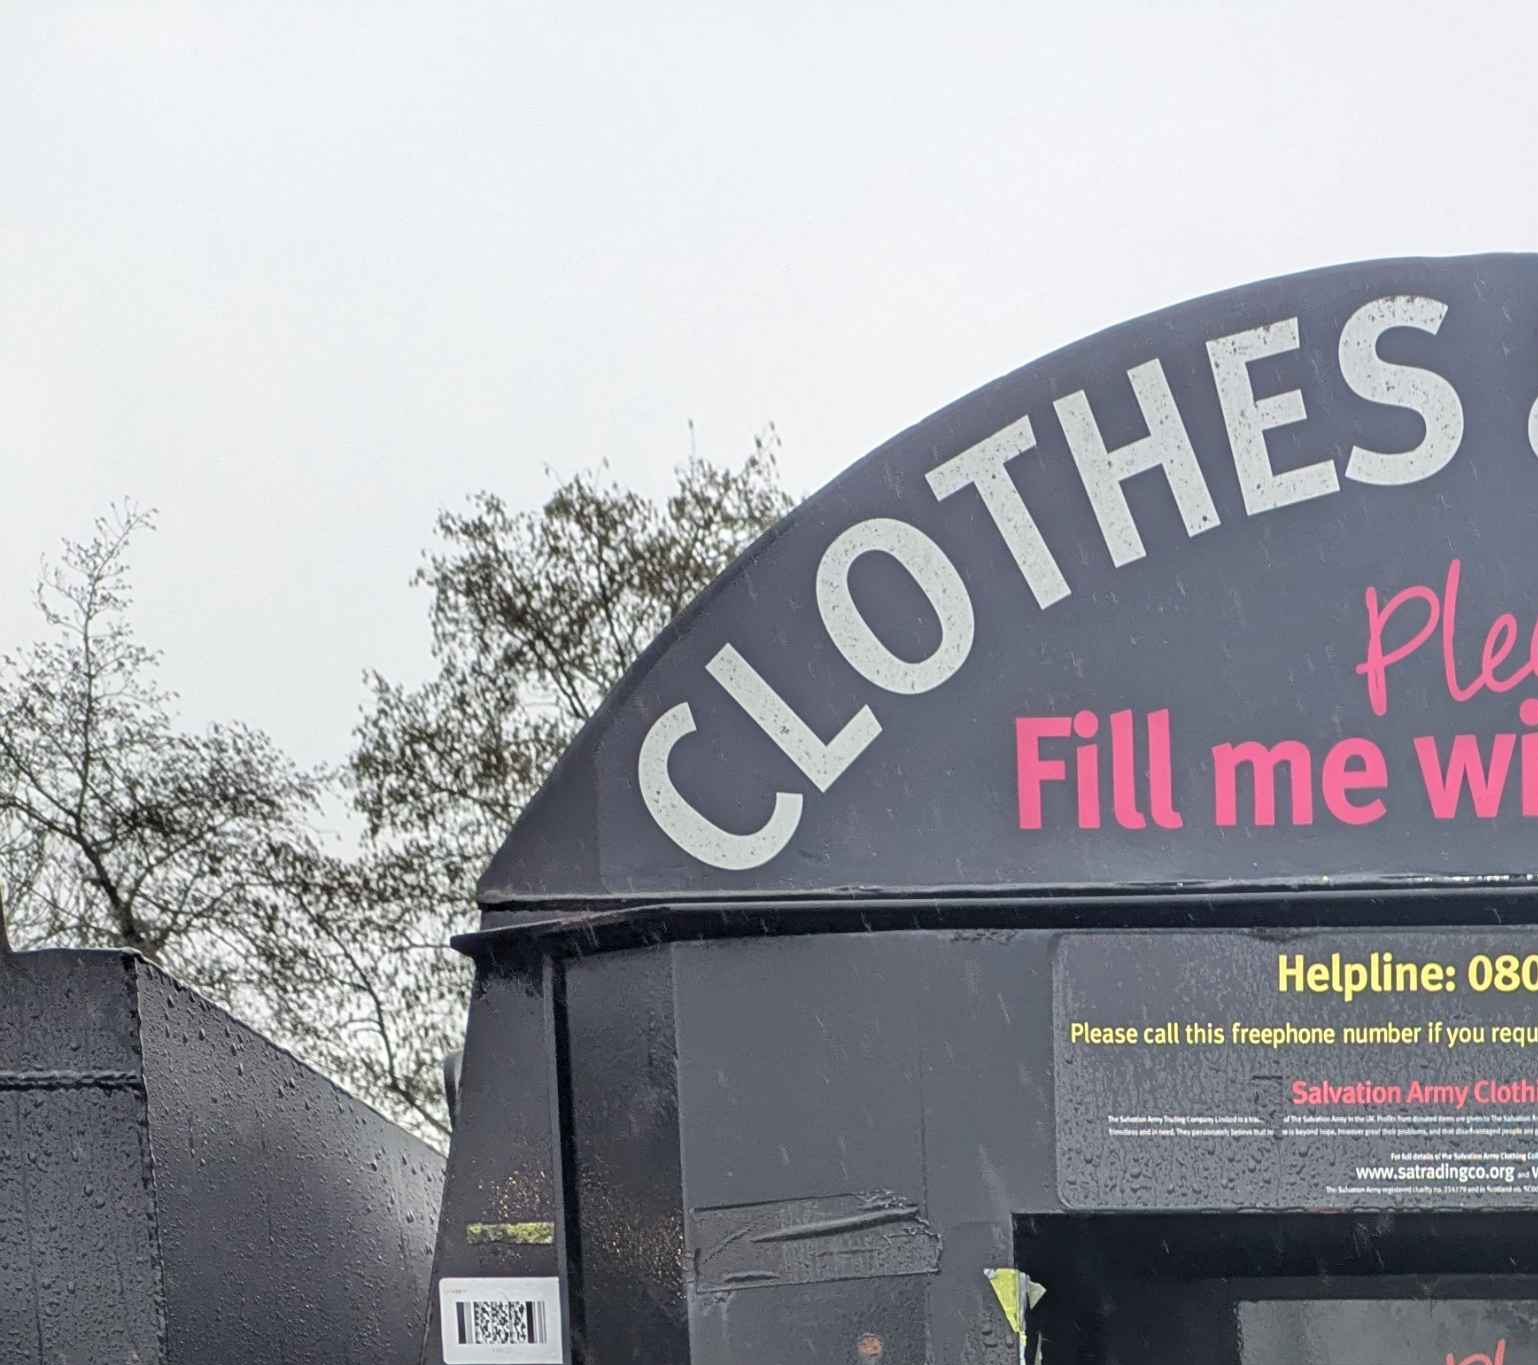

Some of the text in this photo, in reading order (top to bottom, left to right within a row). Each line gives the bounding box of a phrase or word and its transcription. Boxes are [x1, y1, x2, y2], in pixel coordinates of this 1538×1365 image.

[636, 294, 1466, 873] CLOTHES
[1015, 709, 1183, 830] Fill
[1211, 734, 1389, 828] me
[1278, 951, 1457, 1003] Helpline:
[1070, 1023, 1138, 1044] Please
[1143, 1023, 1181, 1047] call
[1184, 1024, 1225, 1046] this
[1230, 1022, 1336, 1047] freephone
[1343, 1023, 1422, 1043] number
[1427, 1021, 1444, 1042] if
[1447, 1027, 1485, 1048] you
[1290, 1079, 1403, 1105] Salvation
[1406, 1080, 1470, 1109] Army
[1354, 1161, 1516, 1183] www.satradingco.org
